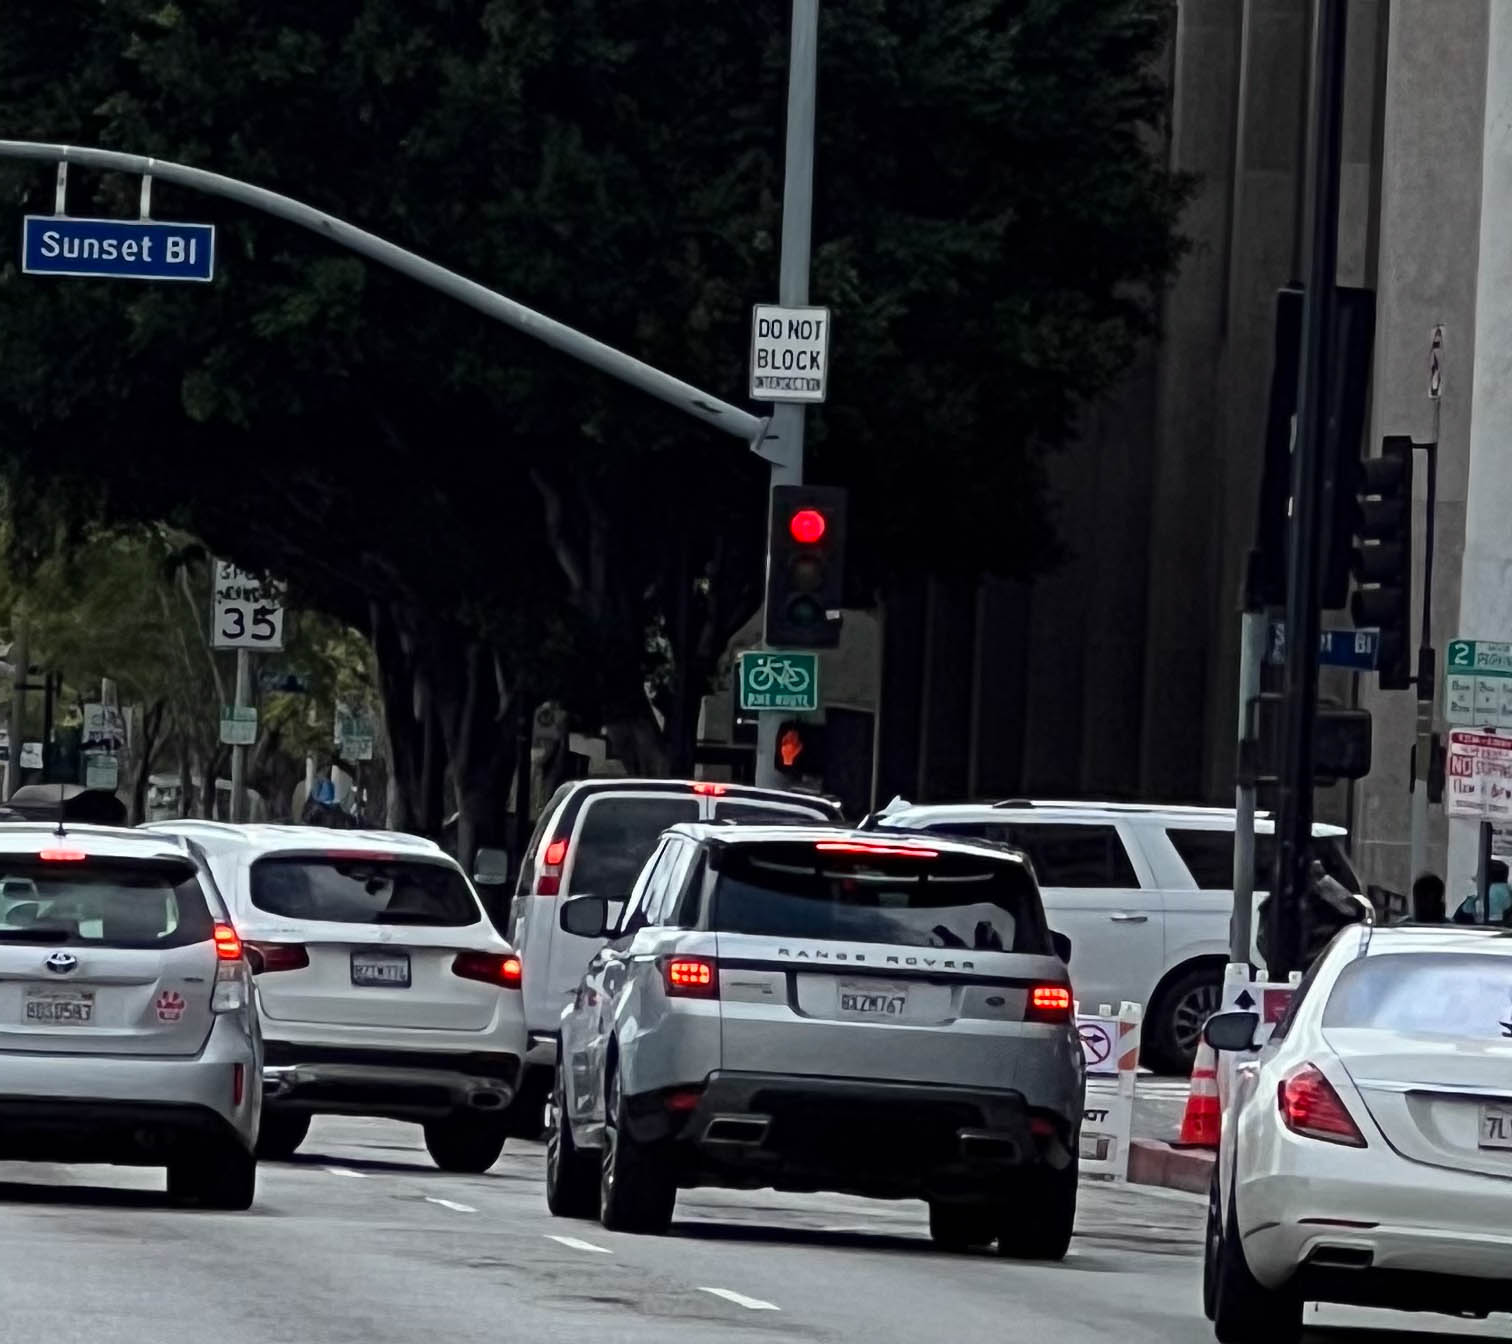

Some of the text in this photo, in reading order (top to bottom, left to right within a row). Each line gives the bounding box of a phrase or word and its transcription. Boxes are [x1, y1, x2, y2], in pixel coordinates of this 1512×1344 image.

[41, 231, 196, 264] Sunset Bl
[758, 319, 824, 341] DO NOT
[757, 348, 821, 370] BLOCK
[222, 608, 276, 641] 35
[1454, 643, 1469, 664] 2
[778, 948, 975, 969] RANGE ROVER
